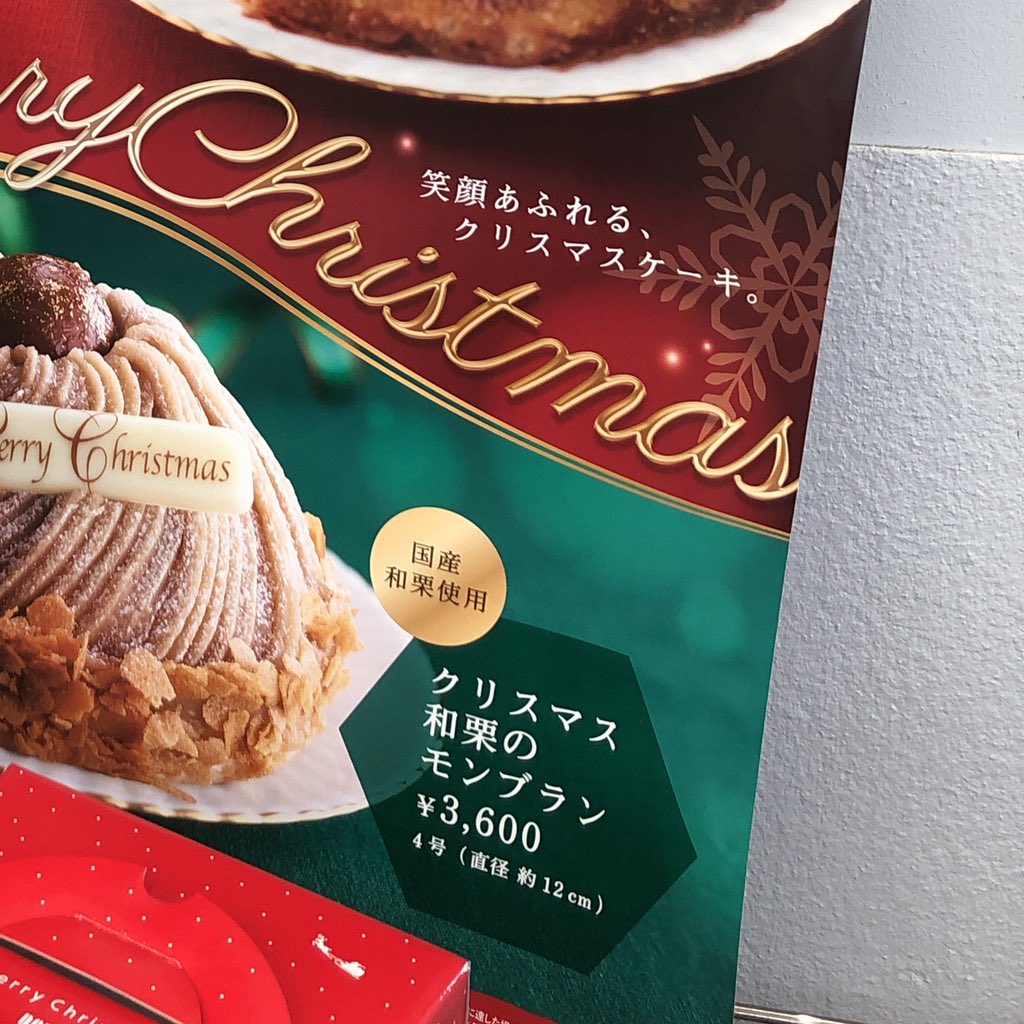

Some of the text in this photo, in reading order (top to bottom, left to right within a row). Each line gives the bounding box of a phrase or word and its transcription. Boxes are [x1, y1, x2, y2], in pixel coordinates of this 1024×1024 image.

[419, 168, 651, 240] 笑顔あふれる、
[129, 79, 800, 501] Christmas
[455, 217, 759, 305] クリスマスケーキ。
[53, 408, 231, 494] Christmas
[384, 566, 488, 613] 和栗使用
[411, 541, 462, 576] 国産
[422, 703, 538, 761] 和栗の
[432, 666, 618, 751] クリスマス
[416, 793, 543, 853] ¥3,600
[421, 747, 606, 827] モンブラン
[50, 999, 105, 1024] Chri
